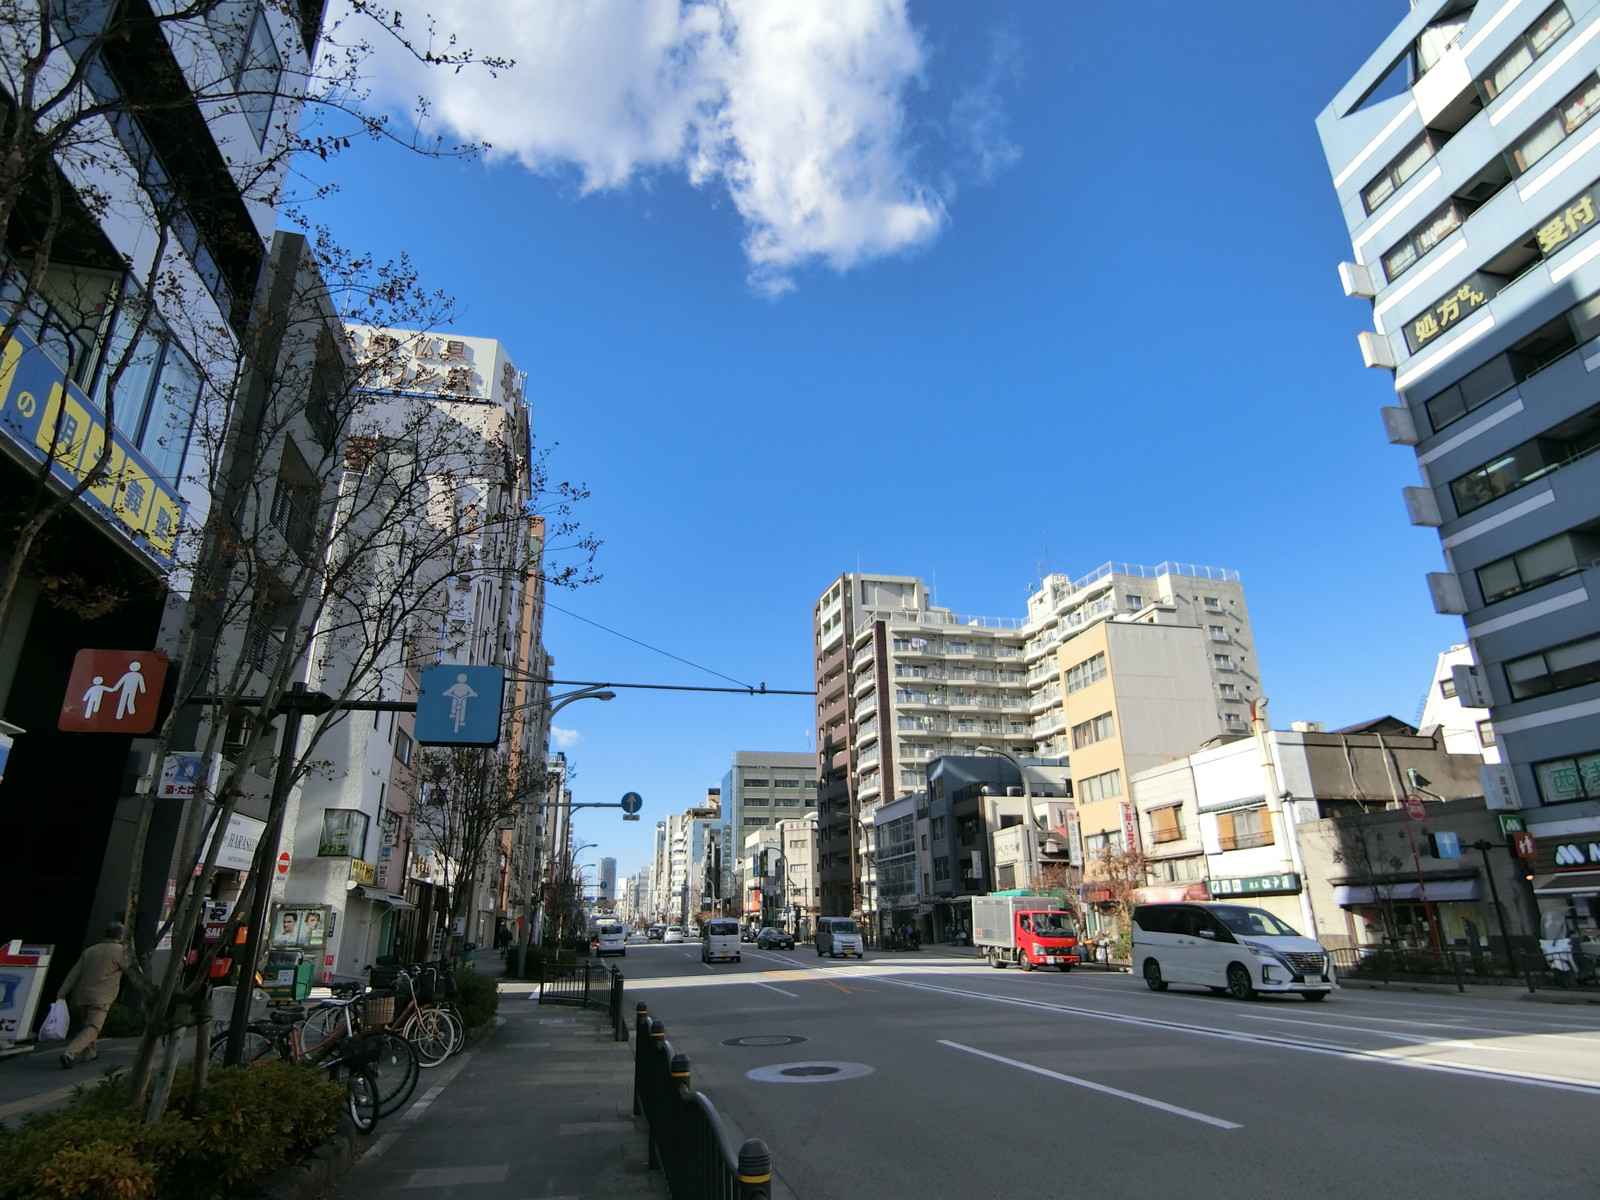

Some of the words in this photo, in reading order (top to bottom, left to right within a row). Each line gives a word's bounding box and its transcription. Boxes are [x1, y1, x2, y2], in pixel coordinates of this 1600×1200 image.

[1537, 196, 1595, 253] 受付
[1415, 283, 1484, 343] 処方せん
